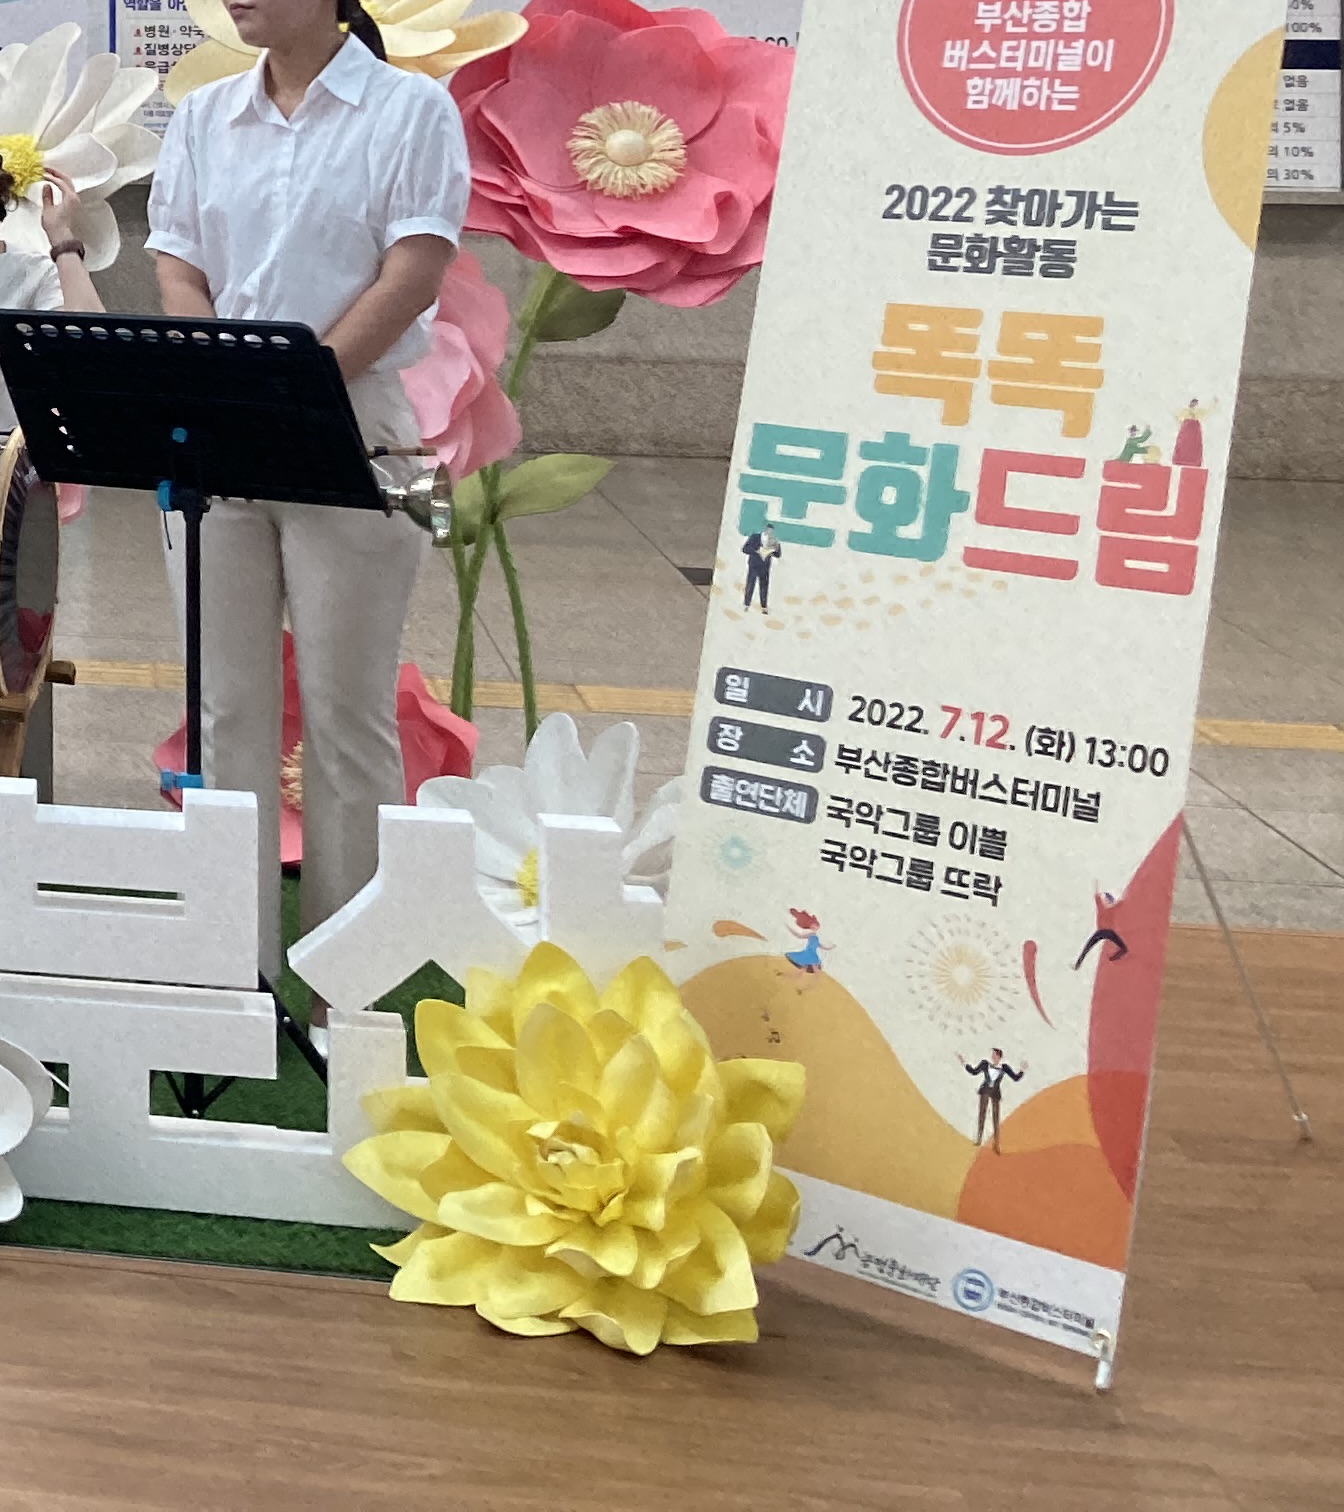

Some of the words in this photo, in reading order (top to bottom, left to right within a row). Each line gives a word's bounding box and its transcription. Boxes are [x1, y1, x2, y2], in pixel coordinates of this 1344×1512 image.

[144, 25, 170, 39] 병원
[973, 0, 1091, 35] 부산종합
[941, 38, 1115, 74] 버스터미널이
[966, 77, 1081, 112] 함께하는
[881, 184, 977, 224] 2022
[984, 184, 1141, 233] 찾아가는
[926, 232, 1078, 279] 문화활동
[871, 302, 1105, 438] 똑똑
[738, 422, 1209, 596] 문화드림
[846, 695, 930, 736] 2022.
[1024, 724, 1077, 764] (화)
[1084, 735, 1171, 778] 13:00
[709, 773, 808, 820] 출연단체
[825, 794, 942, 847] 국악그룹
[833, 743, 1103, 824] 부산종합버스터미널
[819, 838, 936, 892] 국악그룹
[939, 864, 1004, 908] 뜨락
